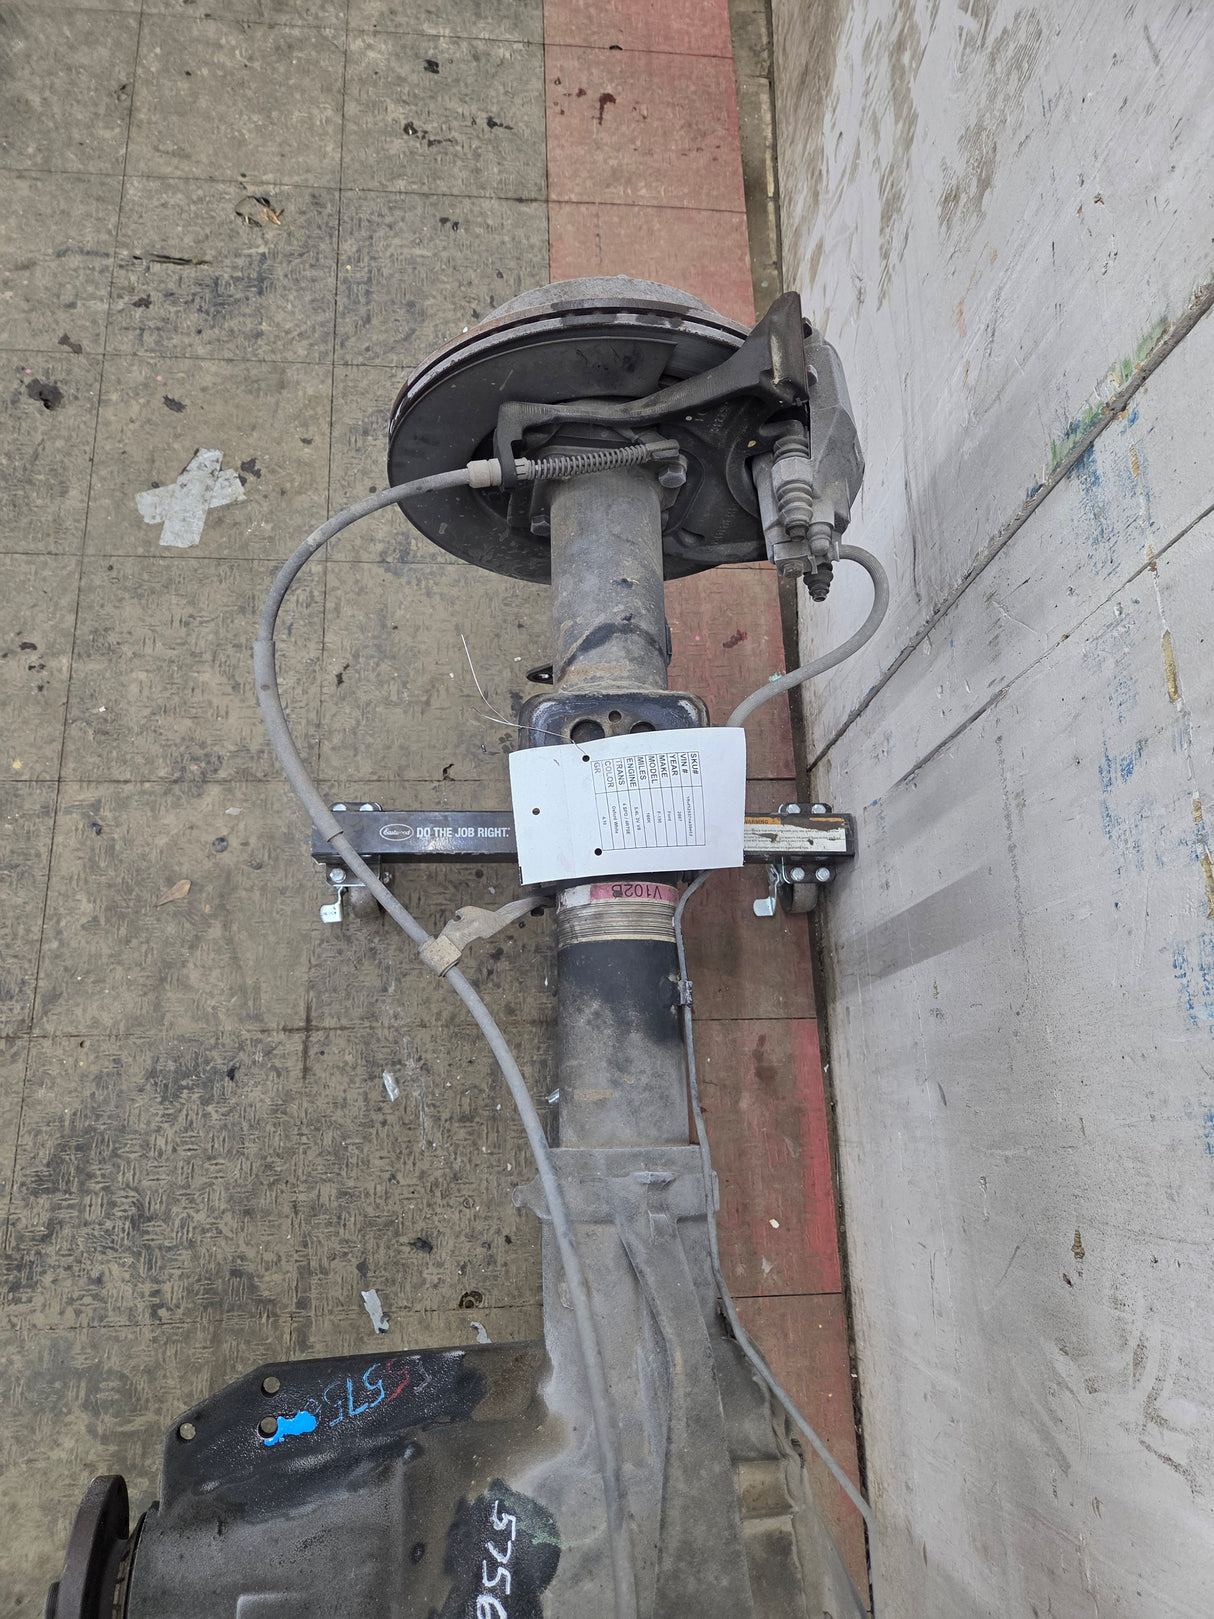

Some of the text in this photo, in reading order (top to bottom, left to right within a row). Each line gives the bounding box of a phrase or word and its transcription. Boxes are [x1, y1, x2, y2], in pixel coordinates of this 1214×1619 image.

[594, 762, 601, 774] GR
[605, 760, 615, 788] COLOR
[616, 760, 626, 786] TRANS
[627, 757, 637, 788] ENGINE
[638, 756, 647, 781] MILES
[648, 755, 658, 785] MODEL
[659, 755, 668, 778] MAKE
[670, 754, 678, 776] YEAR
[691, 753, 699, 775] SKU#
[417, 828, 430, 838] DO
[433, 828, 453, 838] THE
[455, 828, 475, 838] JOB
